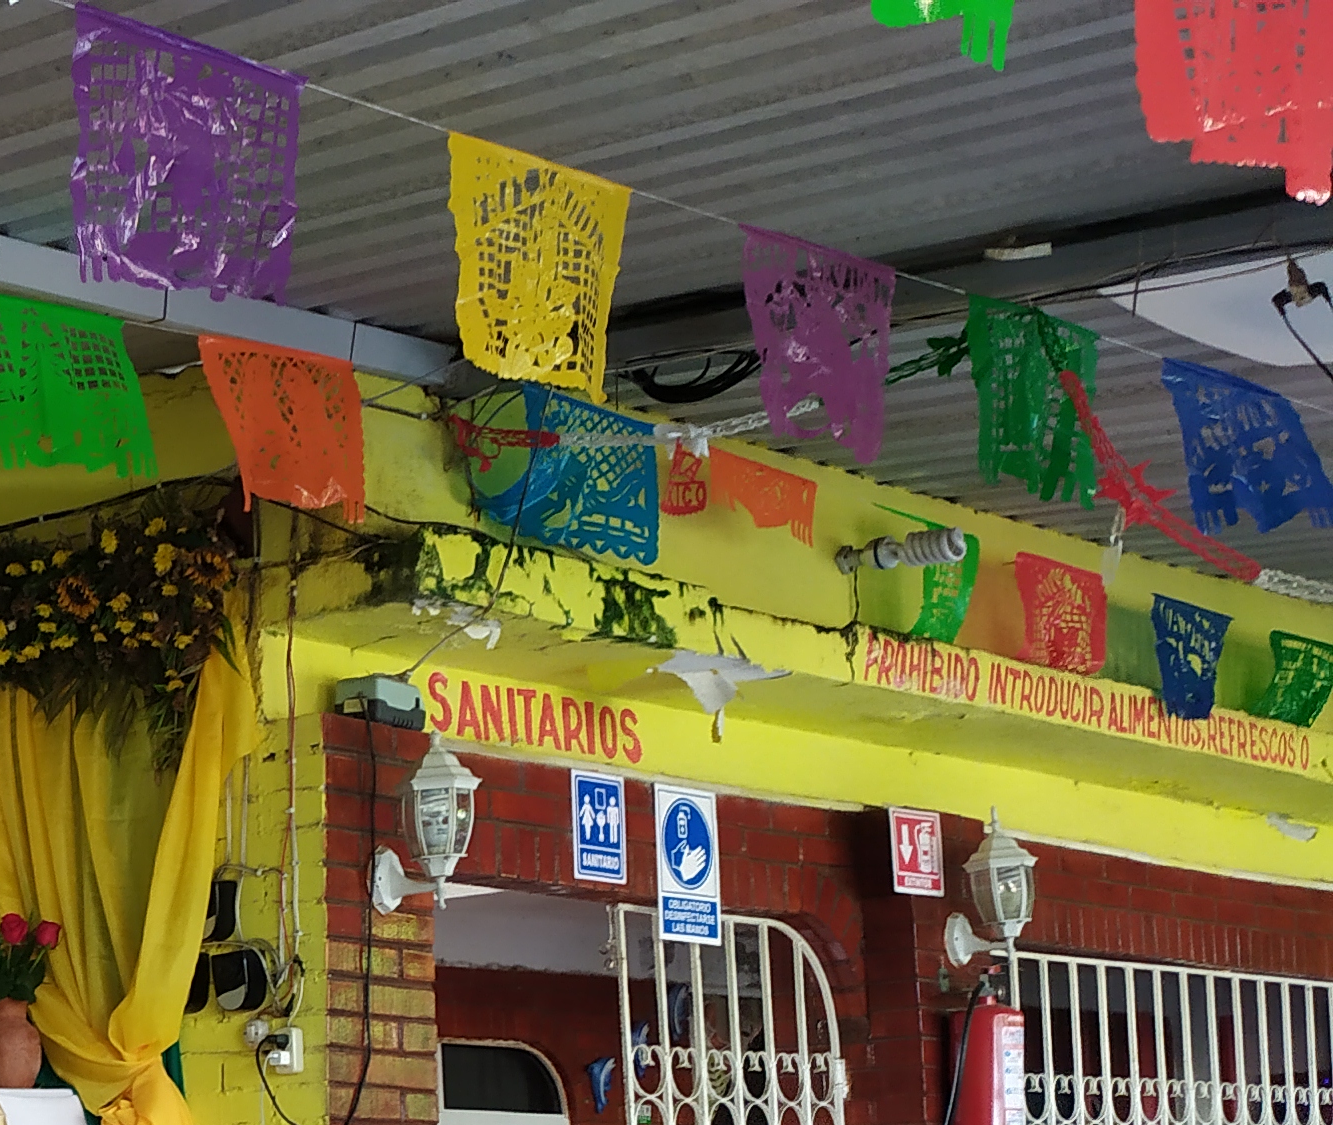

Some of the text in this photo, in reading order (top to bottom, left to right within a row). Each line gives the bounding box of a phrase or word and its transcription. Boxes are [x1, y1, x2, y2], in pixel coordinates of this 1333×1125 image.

[427, 672, 643, 764] SANITARIOS
[864, 631, 980, 702] PROHIBIDO
[988, 661, 1105, 729] INTRODUCIR
[1206, 713, 1296, 769] REFRESCOS
[583, 851, 620, 871] SANITARIO
[671, 922, 685, 933] LAS
